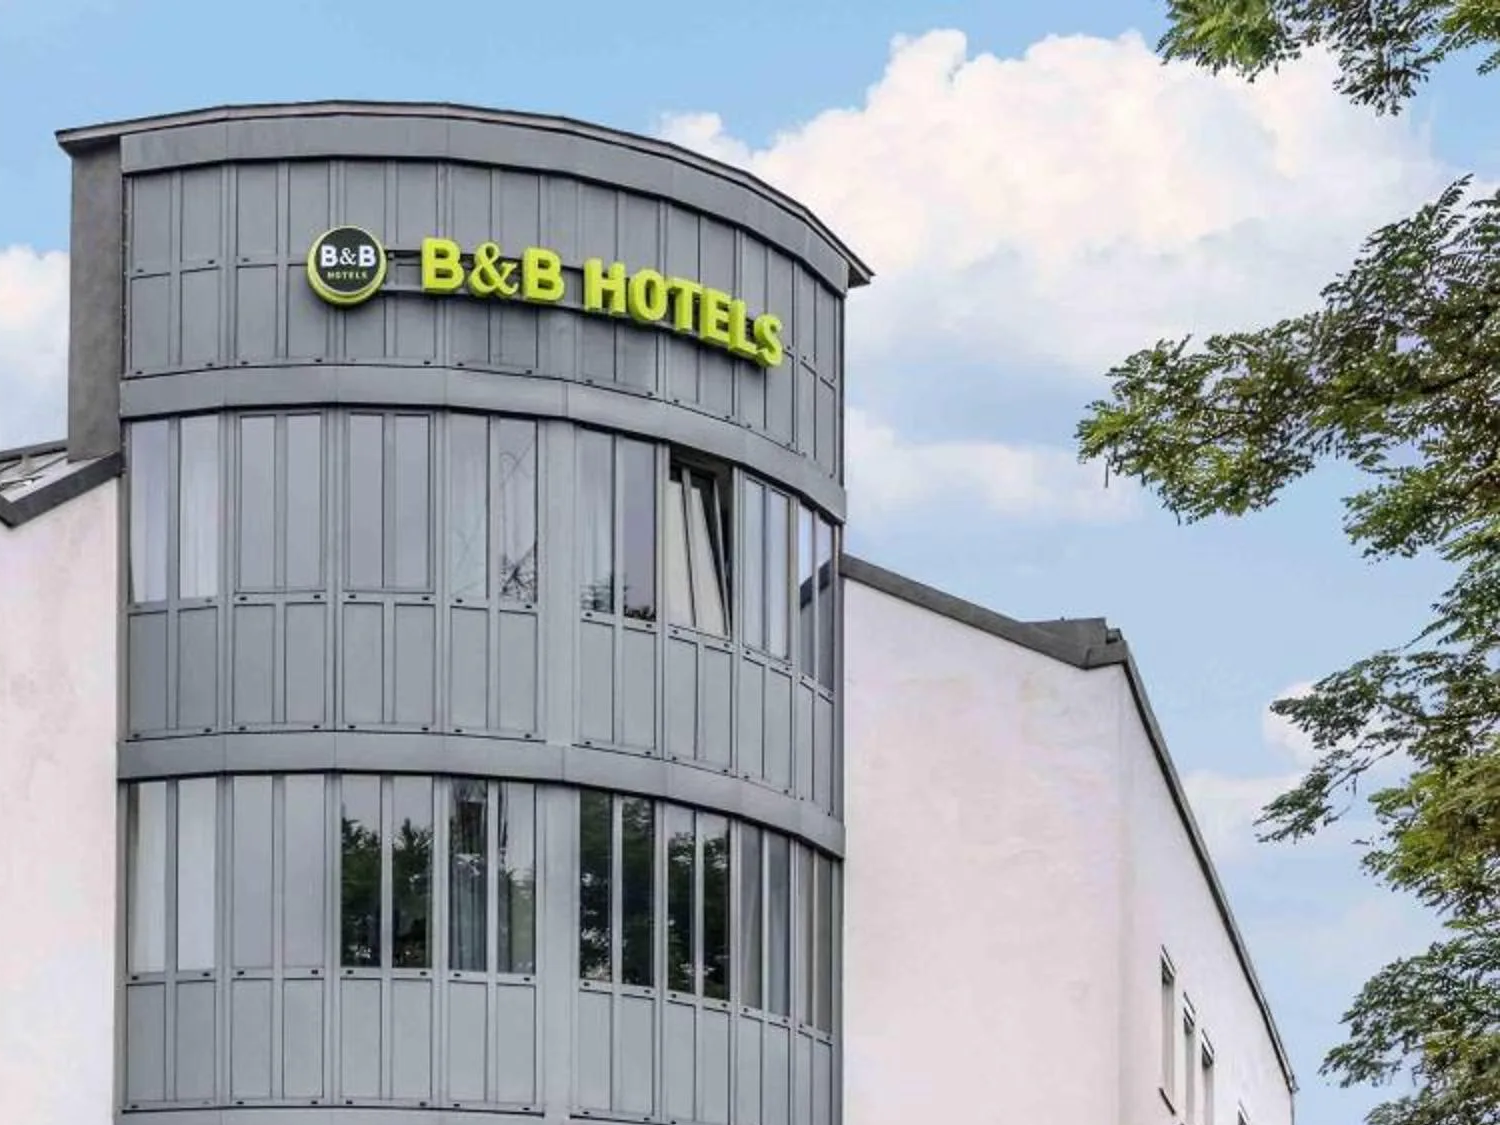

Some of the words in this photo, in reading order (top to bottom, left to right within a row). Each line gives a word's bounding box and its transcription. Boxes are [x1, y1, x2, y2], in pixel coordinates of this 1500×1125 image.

[321, 245, 376, 267] B&B
[421, 237, 564, 301] B&B
[584, 258, 783, 368] HOTELS
